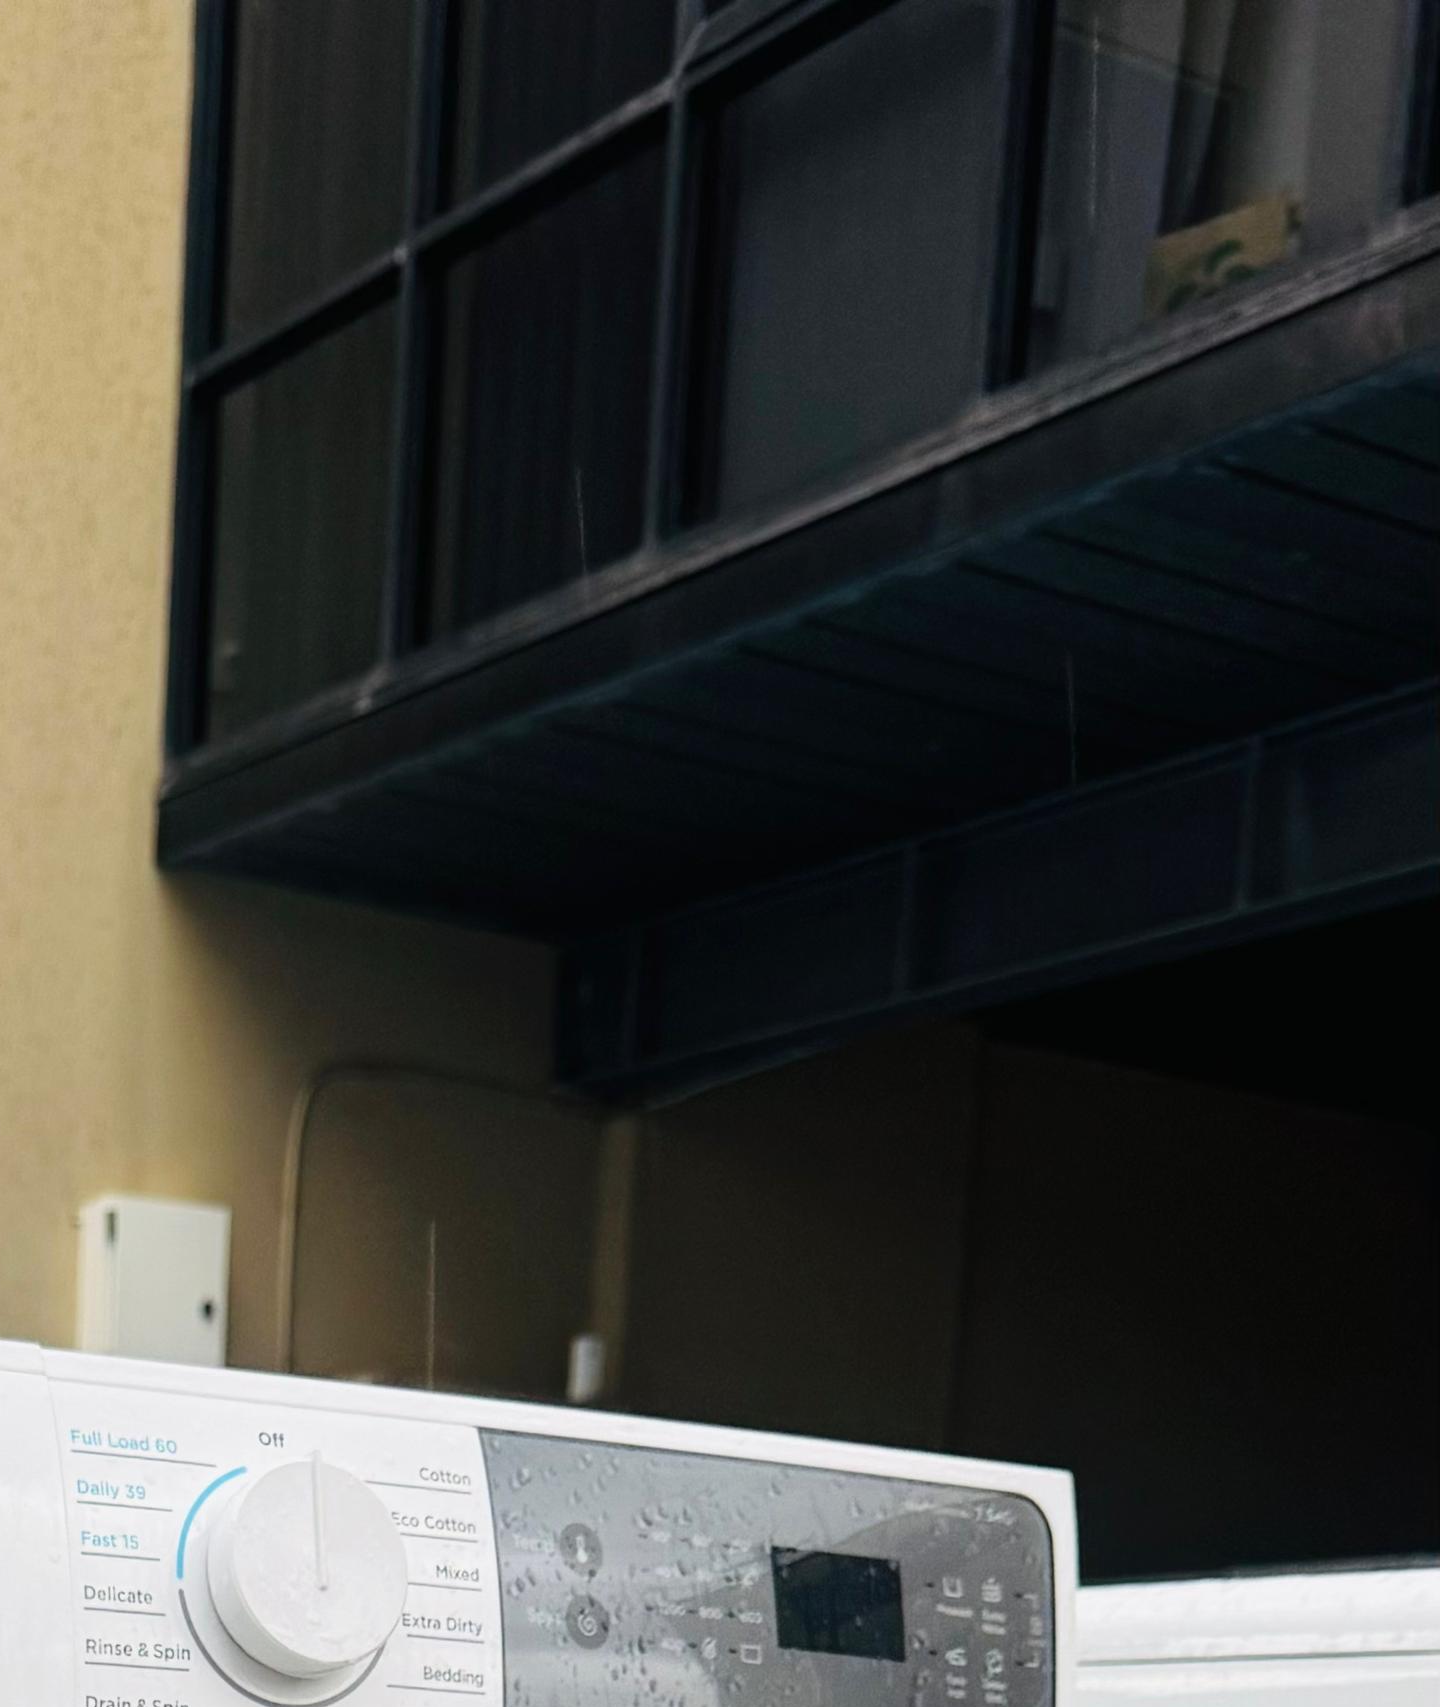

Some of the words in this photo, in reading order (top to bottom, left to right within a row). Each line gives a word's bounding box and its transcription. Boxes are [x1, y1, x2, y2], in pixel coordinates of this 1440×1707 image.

[70, 1429, 102, 1446] Full
[107, 1433, 150, 1451] Load
[155, 1439, 178, 1454] 60
[258, 1432, 285, 1448] Off
[419, 1467, 471, 1487] Cotton
[76, 1479, 120, 1500] Daily
[125, 1485, 146, 1500] 39
[392, 1511, 419, 1528] Eco
[424, 1515, 476, 1535] Cotton
[80, 1531, 117, 1547] Fast
[122, 1534, 139, 1550] 15
[436, 1564, 479, 1583] Mixed
[83, 1585, 153, 1605] Delicate
[402, 1613, 441, 1630] Extra
[447, 1617, 483, 1637] Dirty
[85, 1639, 133, 1656] Rinse
[138, 1643, 149, 1657] &
[153, 1646, 191, 1664] Spin
[423, 1666, 485, 1688] Bedding
